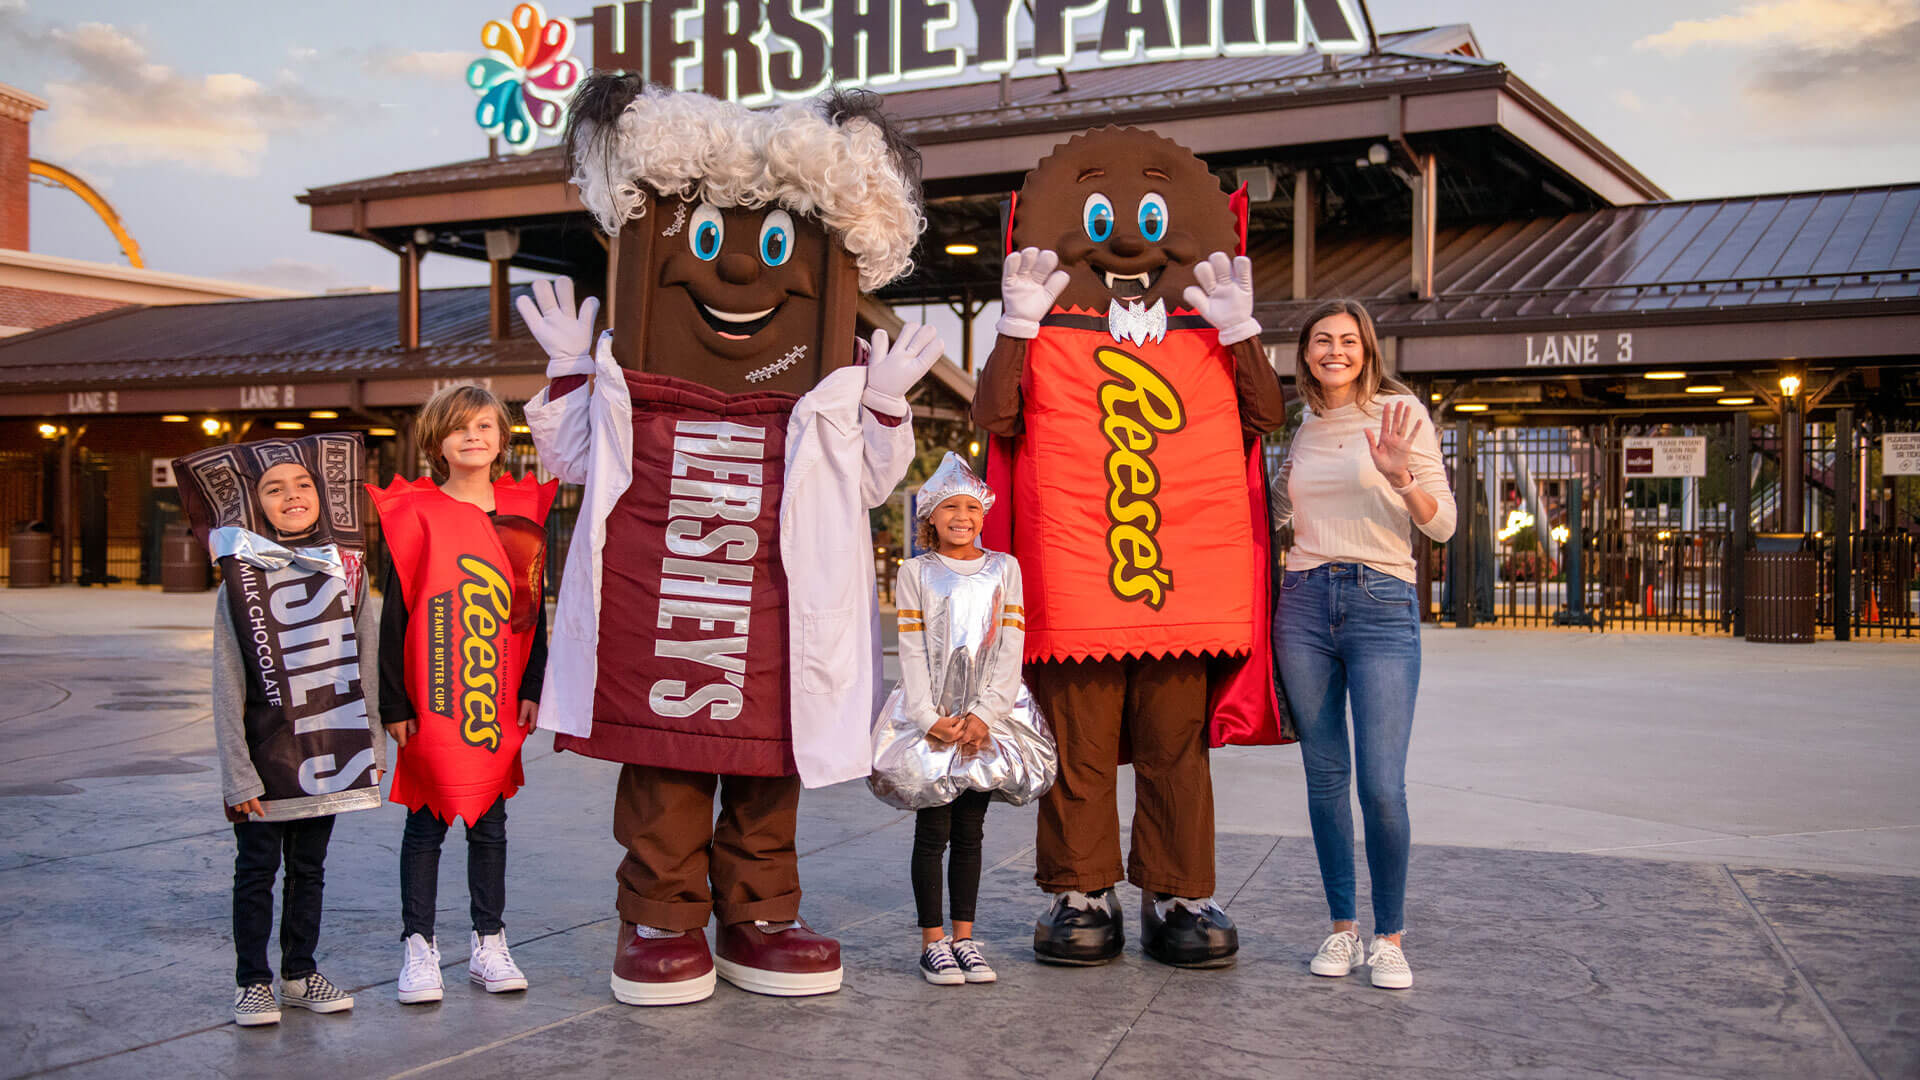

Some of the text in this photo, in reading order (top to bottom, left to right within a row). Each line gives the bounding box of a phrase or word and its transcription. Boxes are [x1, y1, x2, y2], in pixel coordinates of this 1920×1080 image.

[592, 0, 1369, 106] HERSHEYPARK
[1525, 333, 1633, 366] LANE 3
[69, 392, 103, 413] LANE
[240, 385, 296, 409] LANE 8
[326, 440, 349, 524] HERSHEY'S
[1096, 348, 1183, 607] Reese's
[649, 420, 766, 721] HERSHEY'S
[240, 562, 283, 707] MILK CHOCOLATE
[434, 606, 445, 645] PEANUT
[459, 557, 512, 750] Reese's
[434, 647, 445, 685] BUTTER
[434, 687, 446, 712] CUPS
